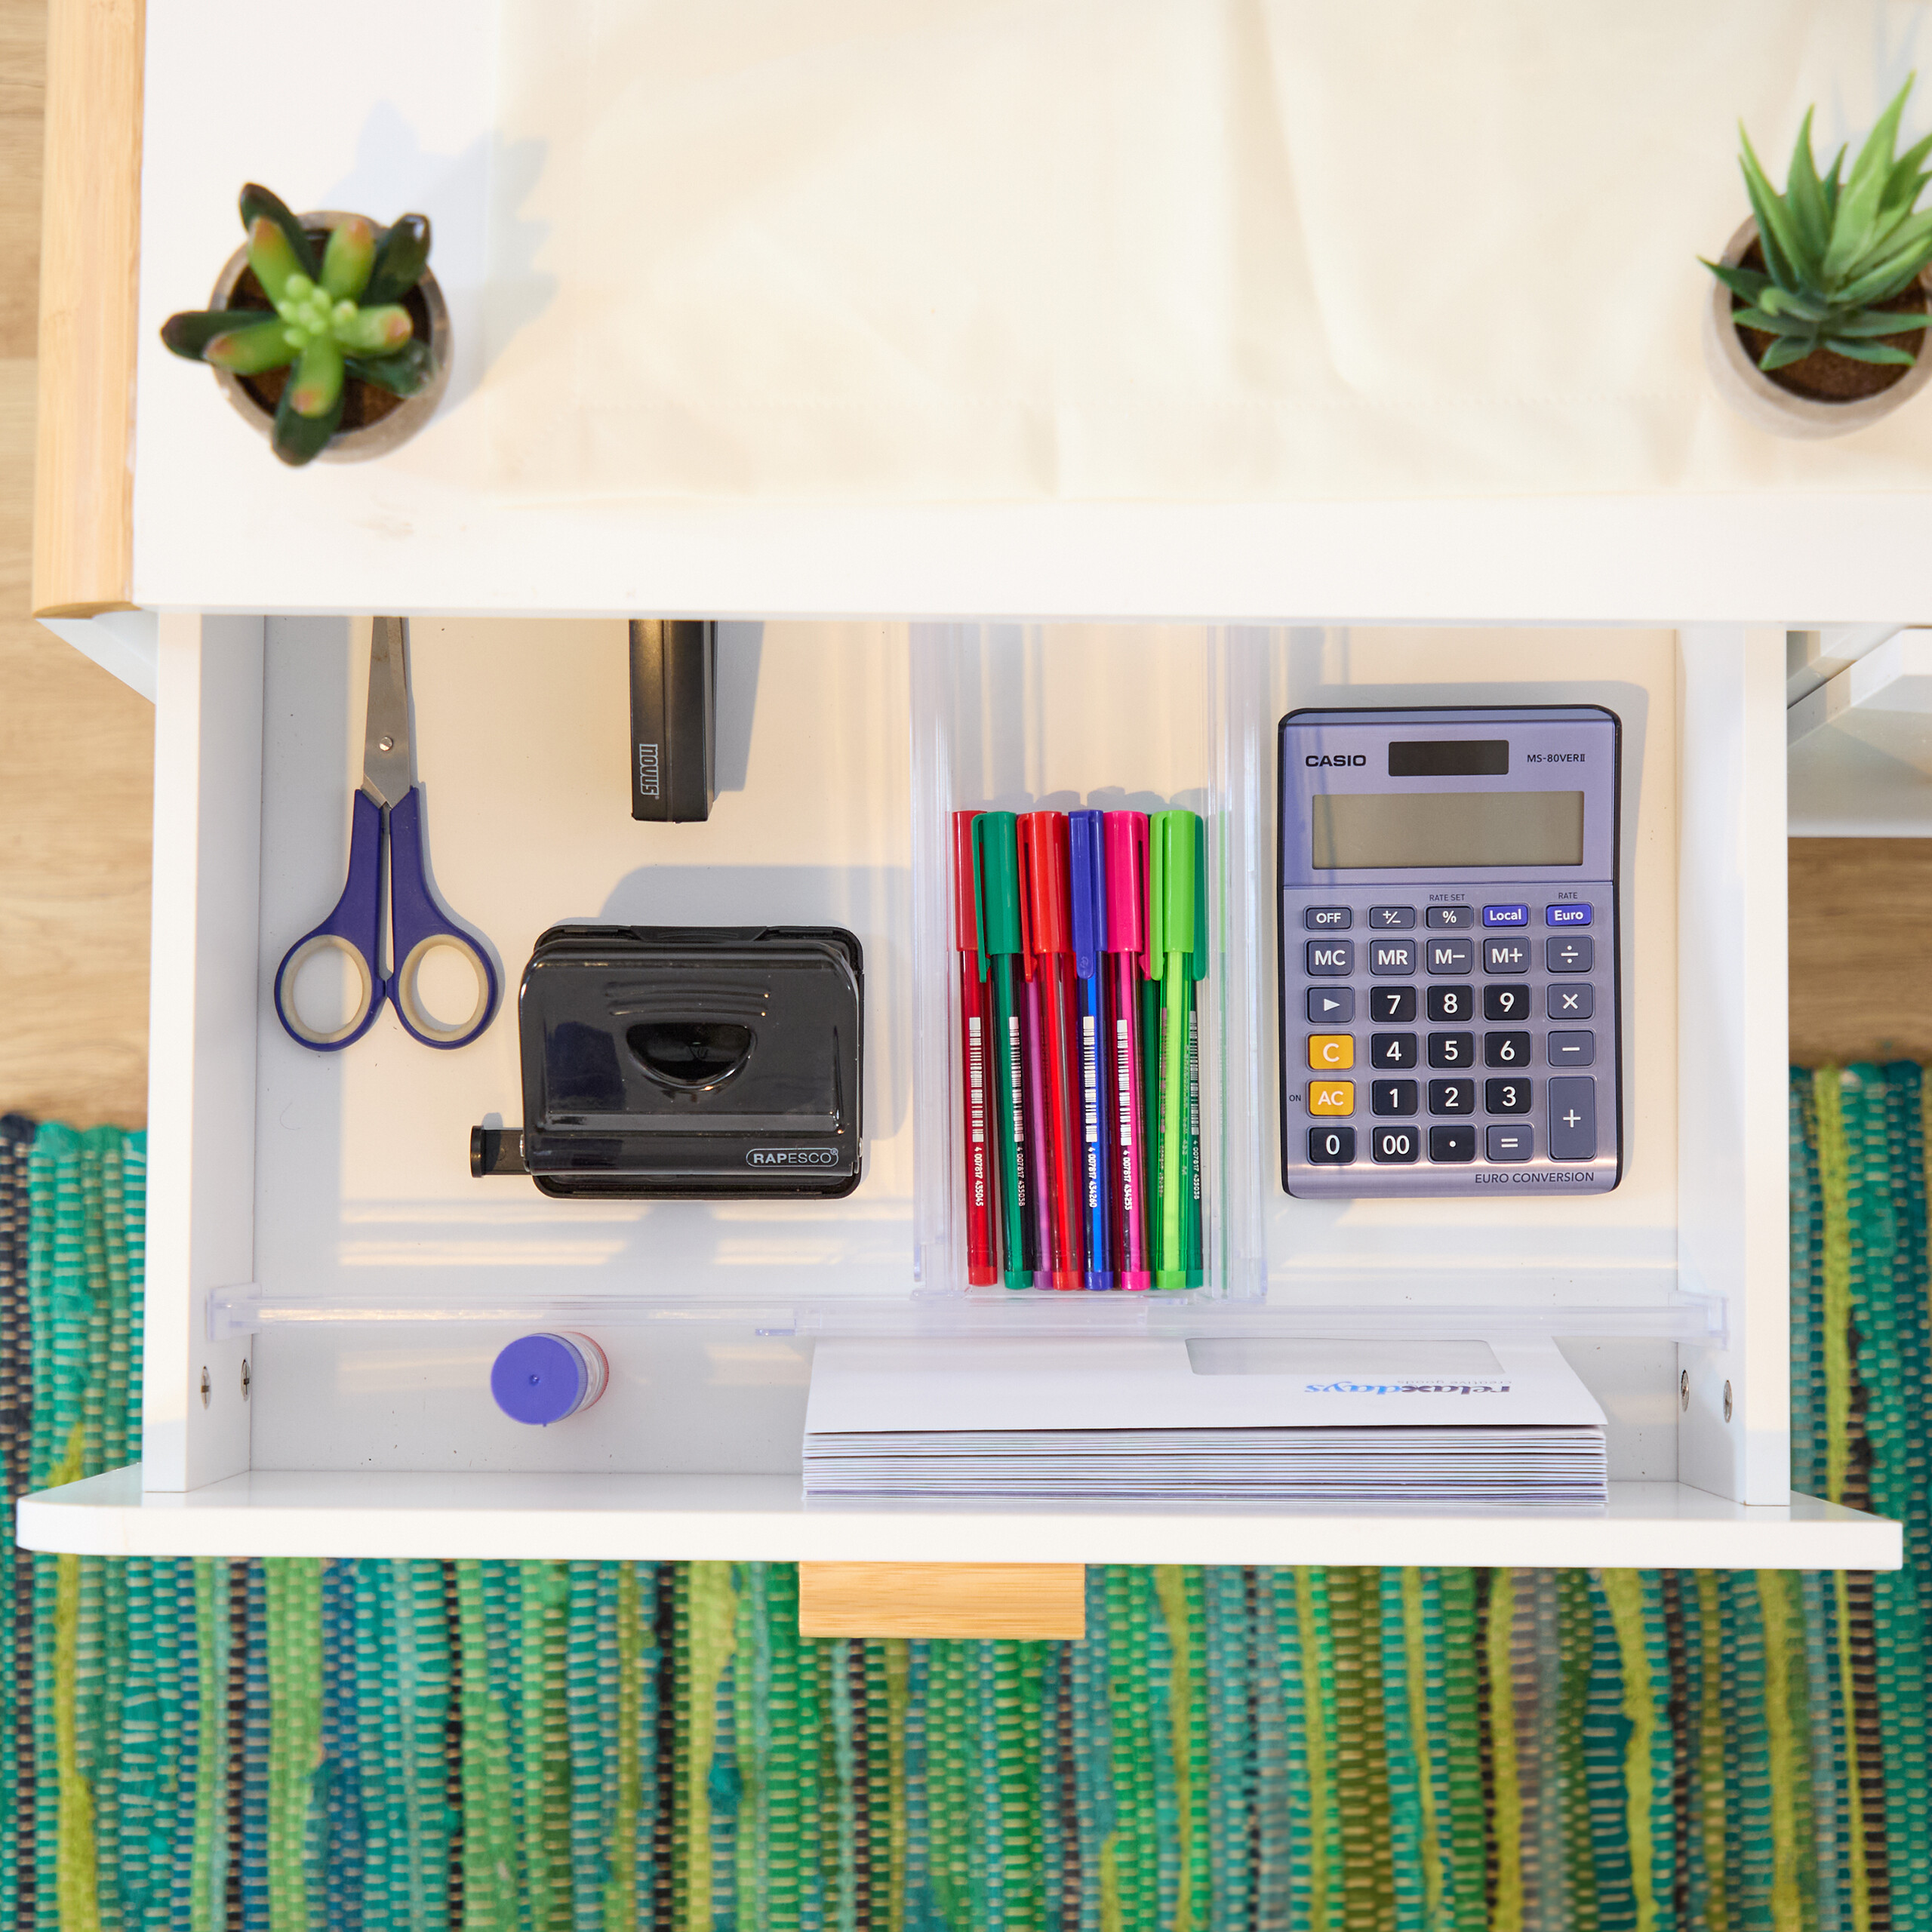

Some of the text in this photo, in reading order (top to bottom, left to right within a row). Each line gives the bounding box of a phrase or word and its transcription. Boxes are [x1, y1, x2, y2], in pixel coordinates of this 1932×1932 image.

[639, 743, 660, 795] novus
[1305, 754, 1367, 768] CASIO
[1451, 893, 1466, 901] SET
[1315, 912, 1341, 924] OFF
[1441, 911, 1457, 924] %
[1489, 909, 1522, 922] Local
[1554, 909, 1584, 921] Euro
[1315, 949, 1346, 967] MC
[1377, 949, 1408, 966] MR
[1491, 947, 1523, 964] M+
[1386, 995, 1401, 1015] 7
[1442, 993, 1458, 1014] 8
[1499, 992, 1515, 1013] 9
[1322, 1042, 1340, 1063] C
[1386, 1041, 1402, 1061] 4
[1444, 1040, 1459, 1061] 5
[1500, 1039, 1516, 1061] 6
[1288, 1094, 1302, 1103] ON
[1316, 1090, 1345, 1106] AC
[1388, 1088, 1399, 1109] 1
[1444, 1087, 1460, 1108] 2
[1501, 1085, 1517, 1107] 3
[1325, 1134, 1341, 1155] 0
[1382, 1134, 1411, 1155] 00
[974, 1153, 983, 1180] 007817
[1017, 1153, 1025, 1179] 007817
[1088, 1153, 1097, 1180] 007817
[1122, 1156, 1132, 1183] 007817
[1474, 1171, 1595, 1184] EURO CONVERSION
[974, 1180, 984, 1207] 435045
[1017, 1180, 1026, 1207] 435038
[1088, 1180, 1098, 1208] 434260
[1304, 1381, 1510, 1395] relaxdays
